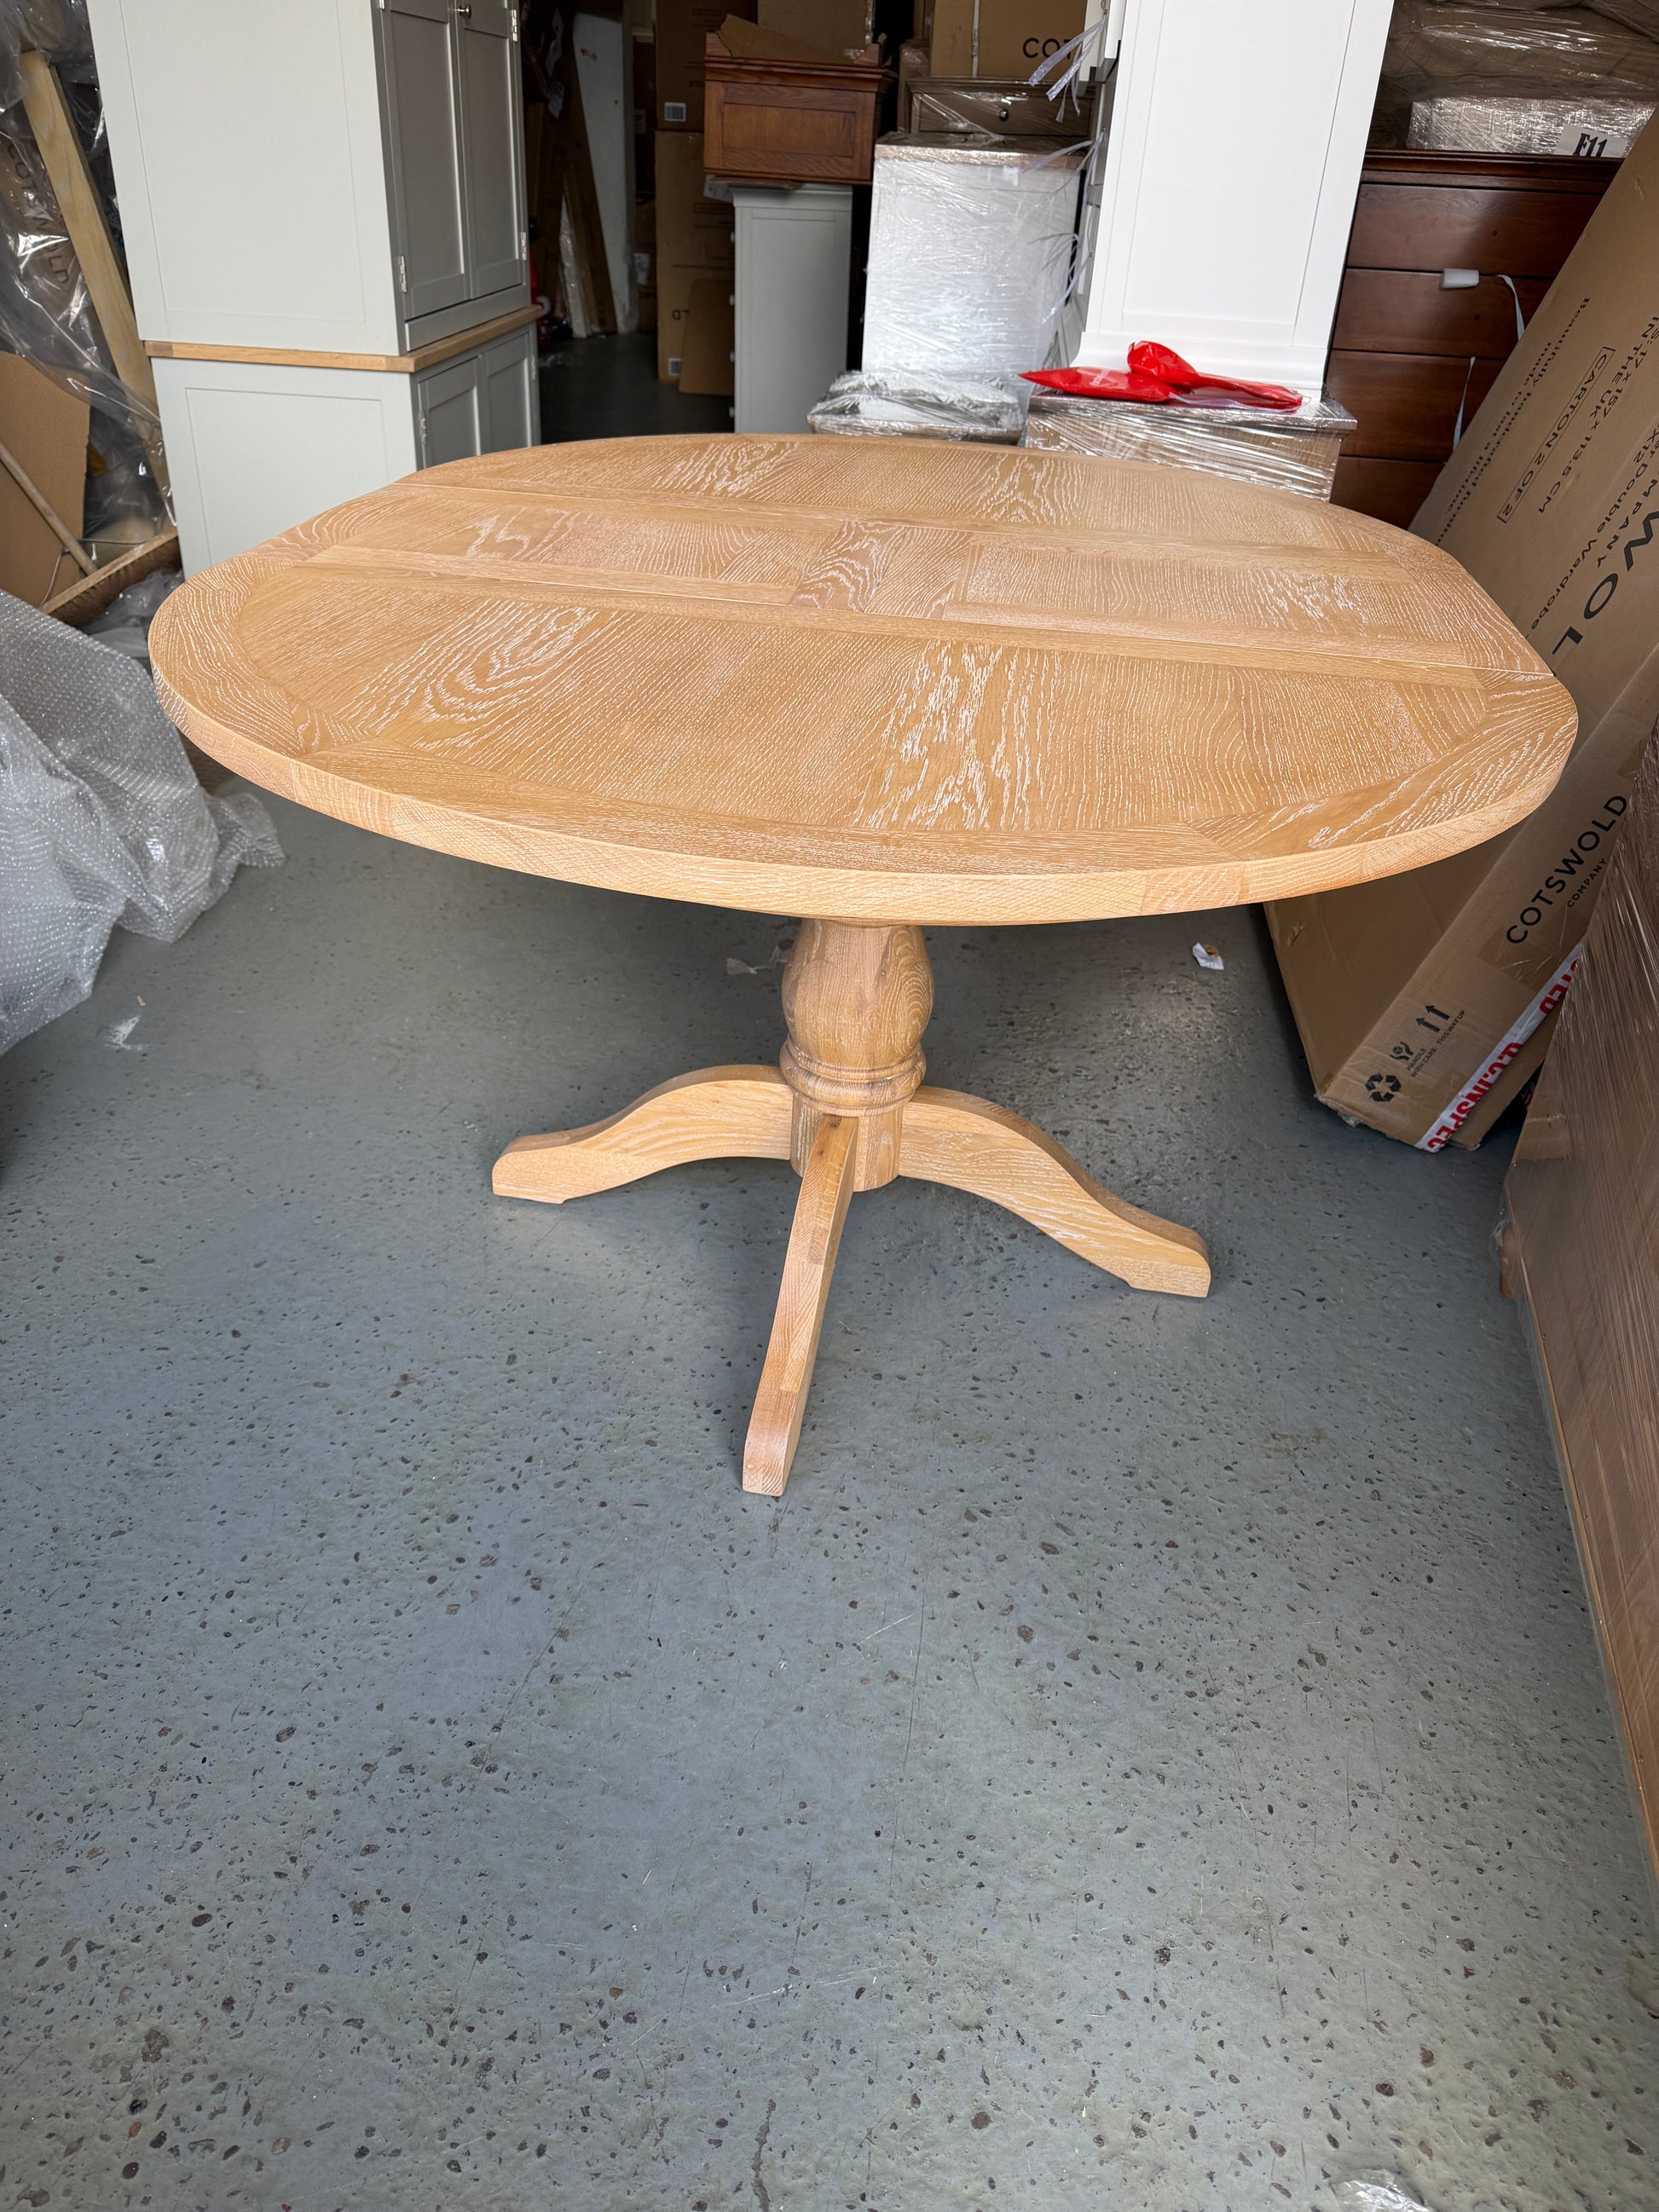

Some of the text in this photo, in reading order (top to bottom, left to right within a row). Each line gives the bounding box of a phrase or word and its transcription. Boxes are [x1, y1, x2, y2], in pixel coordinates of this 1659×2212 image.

[1523, 342, 1551, 386] made
[1534, 298, 1590, 386] Beautifully
[1611, 344, 1643, 384] THE
[1635, 349, 1648, 369] 17
[1589, 390, 1612, 419] UK
[1603, 388, 1624, 418] 157
[1470, 392, 1531, 487] handcrafted
[1503, 354, 1607, 517] CARTON 2 OF 2
[1562, 436, 1593, 477] 113.5
[1538, 482, 1561, 513] CM
[1597, 463, 1648, 534] Double
[1597, 476, 1659, 569] MPANY
[1531, 539, 1598, 630] Wardrobe
[1552, 510, 1659, 661] WOL
[1506, 795, 1627, 944] COTSWOLD
[1567, 858, 1607, 908] COMPANY
[1436, 1009, 1465, 1045] THIS WAY UP
[1406, 1048, 1427, 1071] HANDLE
[1411, 1047, 1437, 1077] WITH CARE
